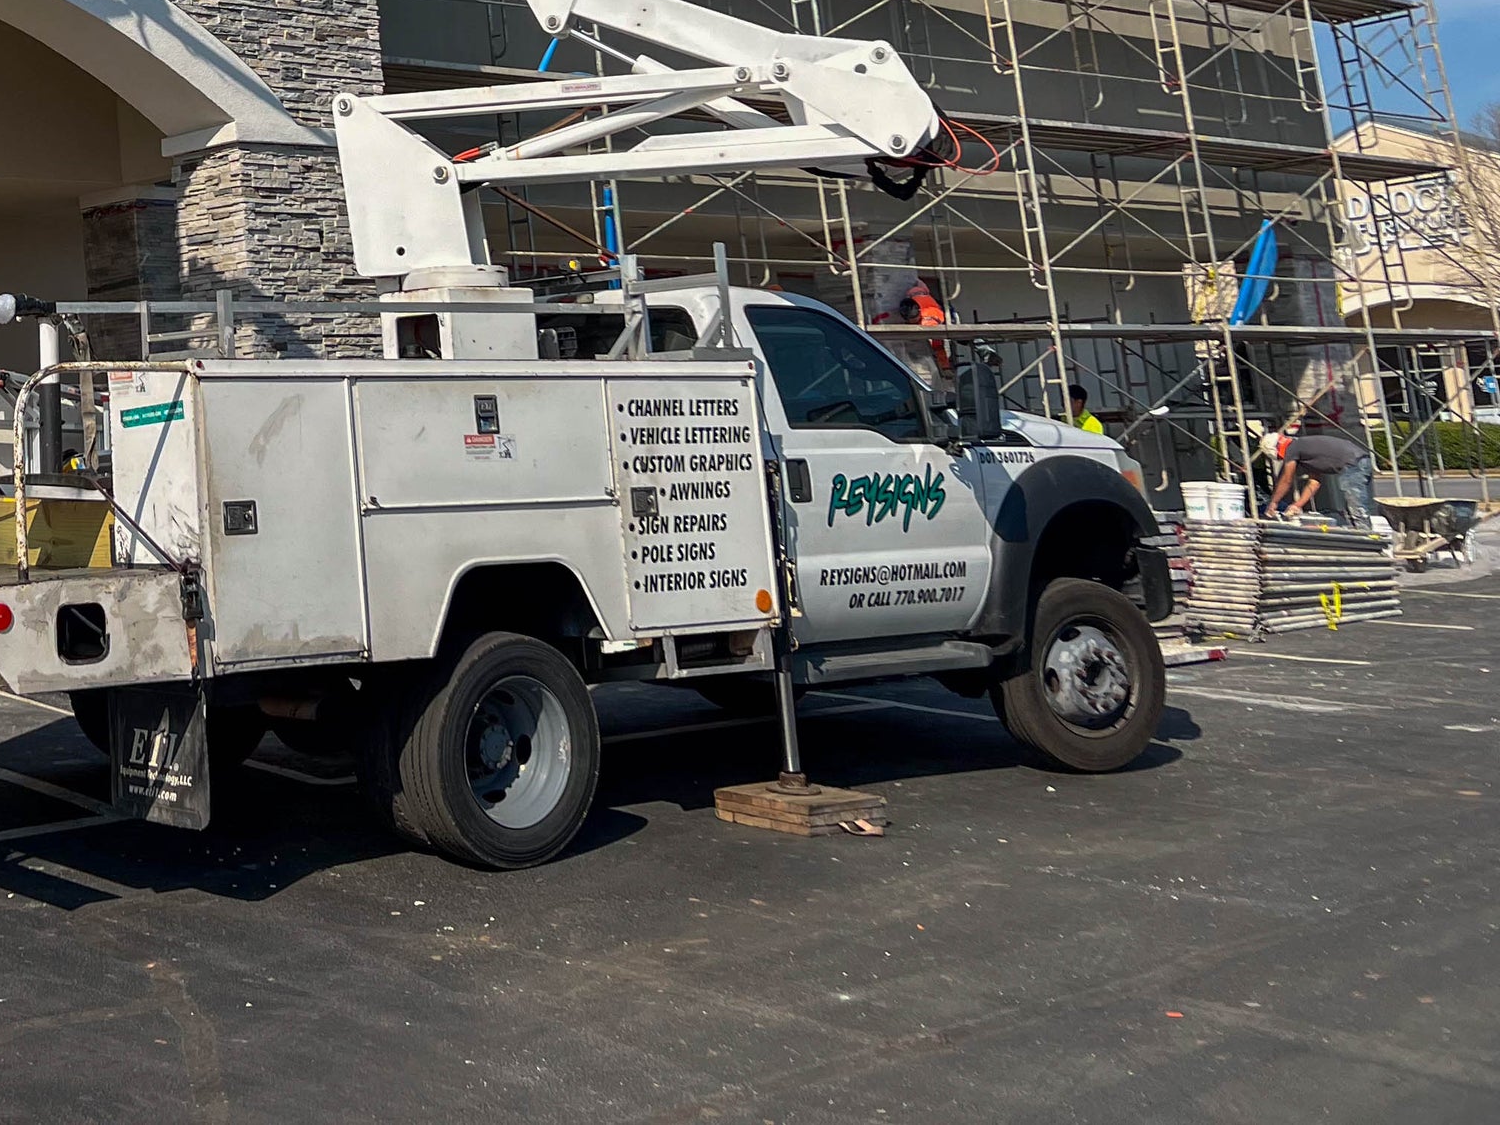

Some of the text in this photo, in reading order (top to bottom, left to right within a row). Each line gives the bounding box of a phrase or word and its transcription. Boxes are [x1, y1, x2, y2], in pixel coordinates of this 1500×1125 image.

[627, 399, 739, 417] CHANNEL LETTERS
[630, 426, 751, 445] VEHICLE LETTERING
[632, 453, 753, 474] CUSTOM GRAPHICS
[979, 451, 1035, 464] DOT 3601726
[668, 481, 731, 501] AWNINGS
[827, 462, 946, 534] REYSIGNS
[638, 514, 728, 535] SIGN REPAIRS
[641, 542, 716, 564] POLE SIGNS
[644, 569, 748, 593] INTERIOR SIGNS
[819, 561, 967, 586] REYSIGNS@HOTMAIL.COM
[848, 586, 965, 609] OR CALL 770.900.7017
